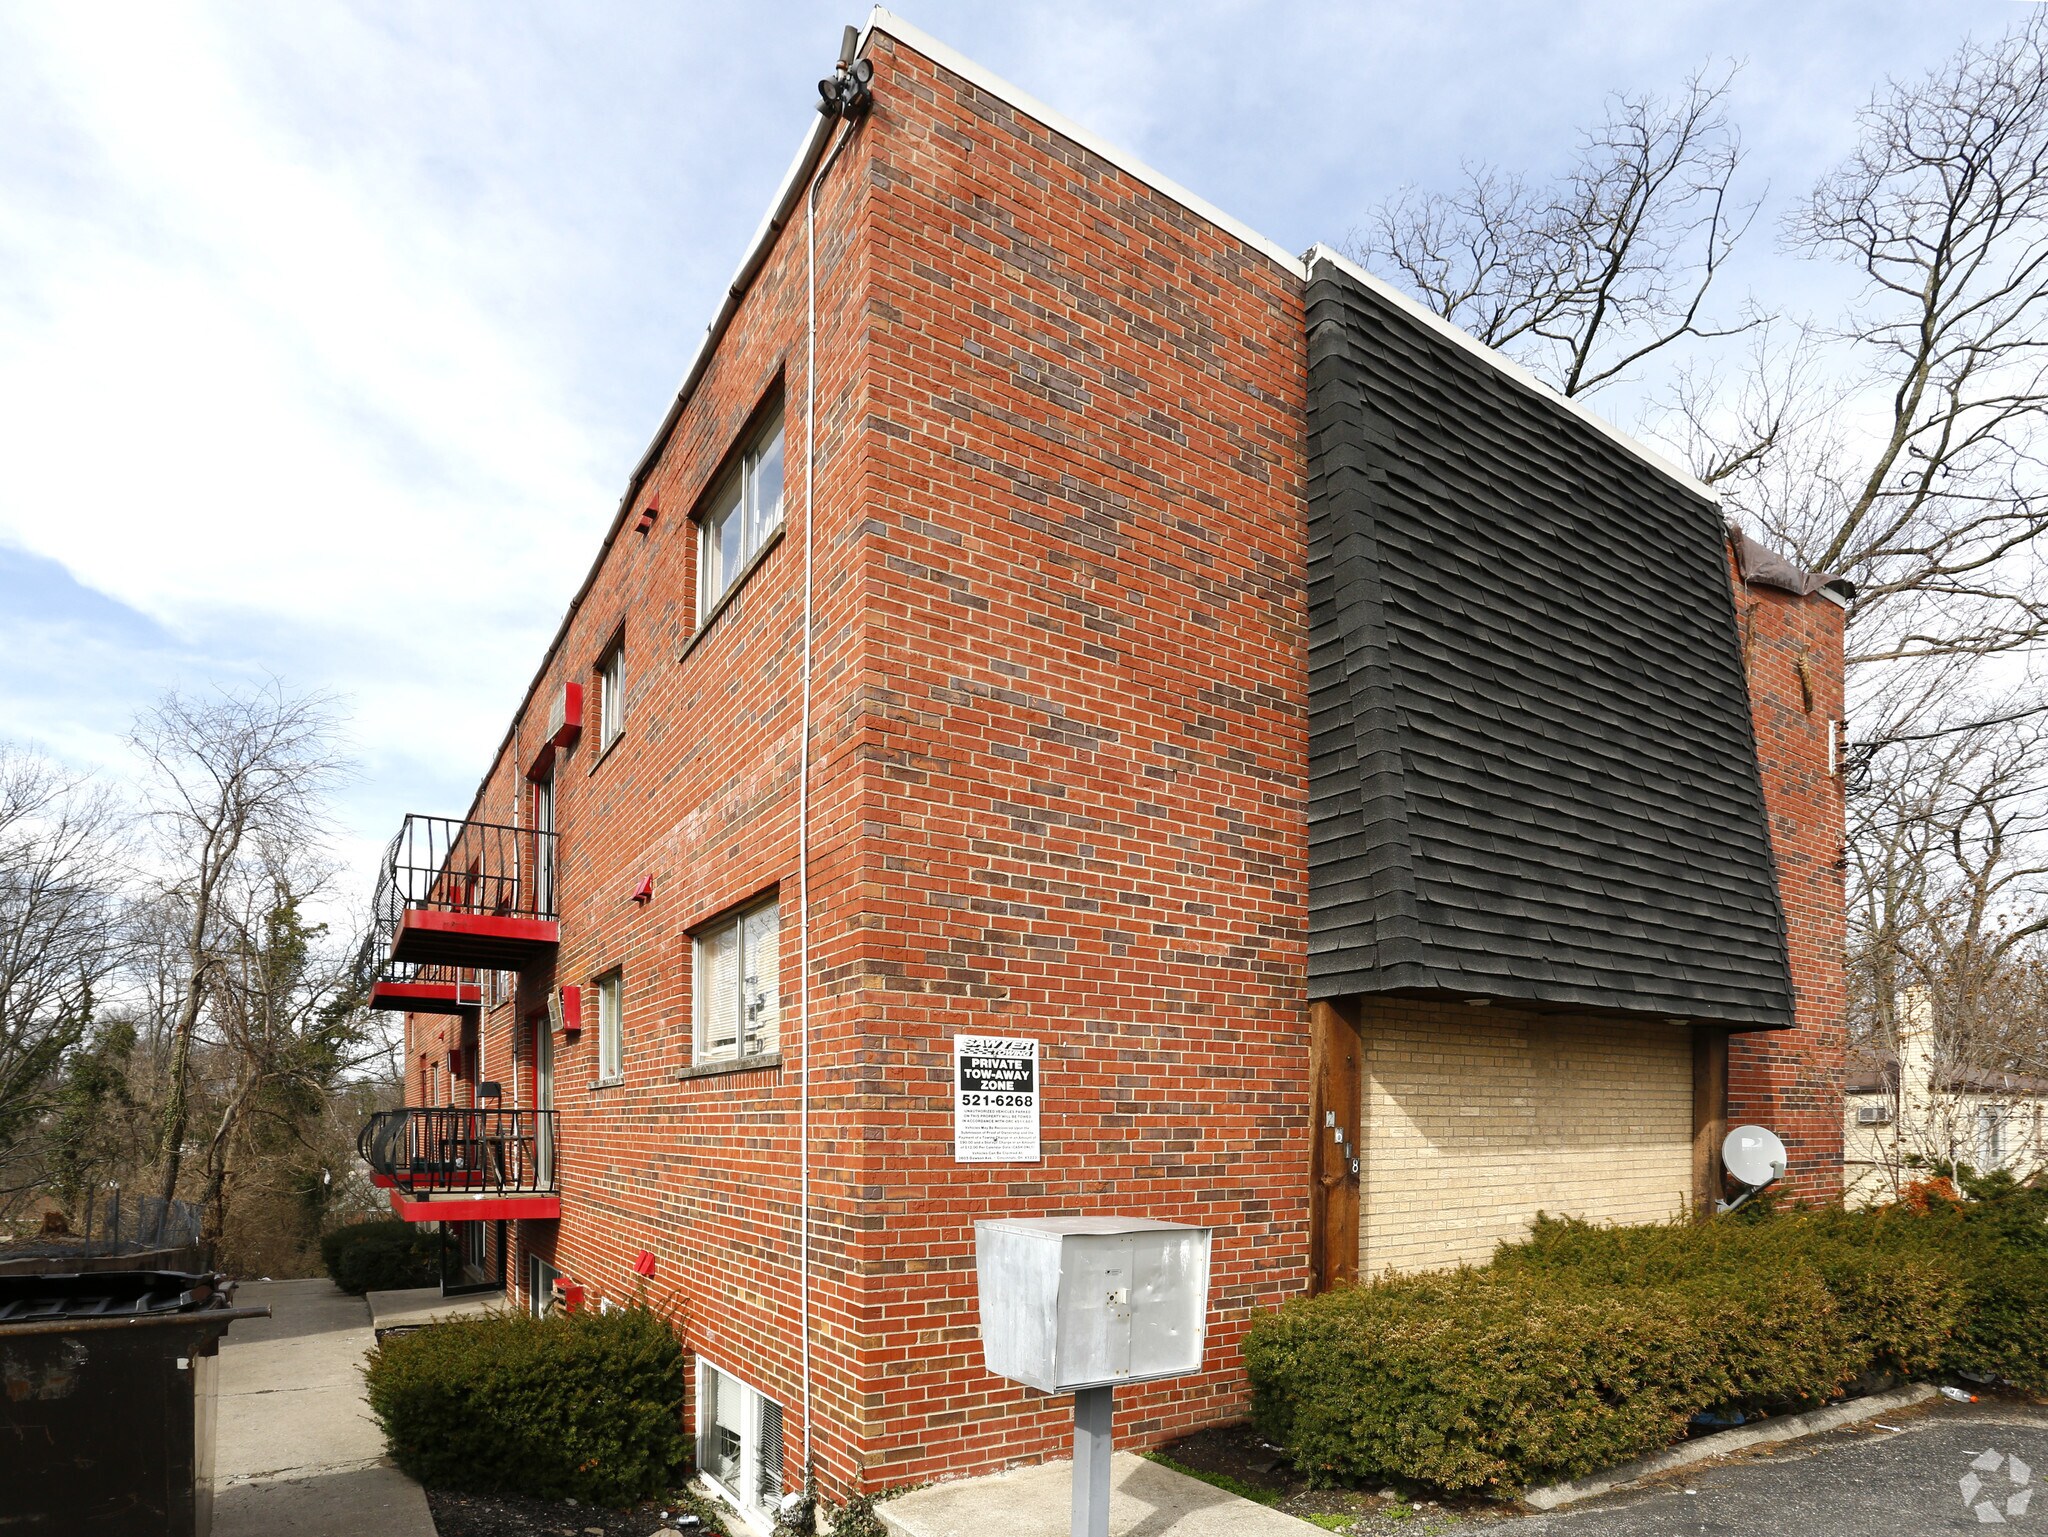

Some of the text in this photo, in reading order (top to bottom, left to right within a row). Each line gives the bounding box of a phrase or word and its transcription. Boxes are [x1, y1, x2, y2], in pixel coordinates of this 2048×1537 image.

[963, 1038, 1034, 1051] SAWYER
[992, 1049, 1033, 1057] TOWING
[971, 1058, 1023, 1070] PRIVATE
[963, 1068, 1030, 1081] TOW-AWAY
[980, 1080, 1015, 1091] ZONE
[962, 1094, 1033, 1107] 521-6268
